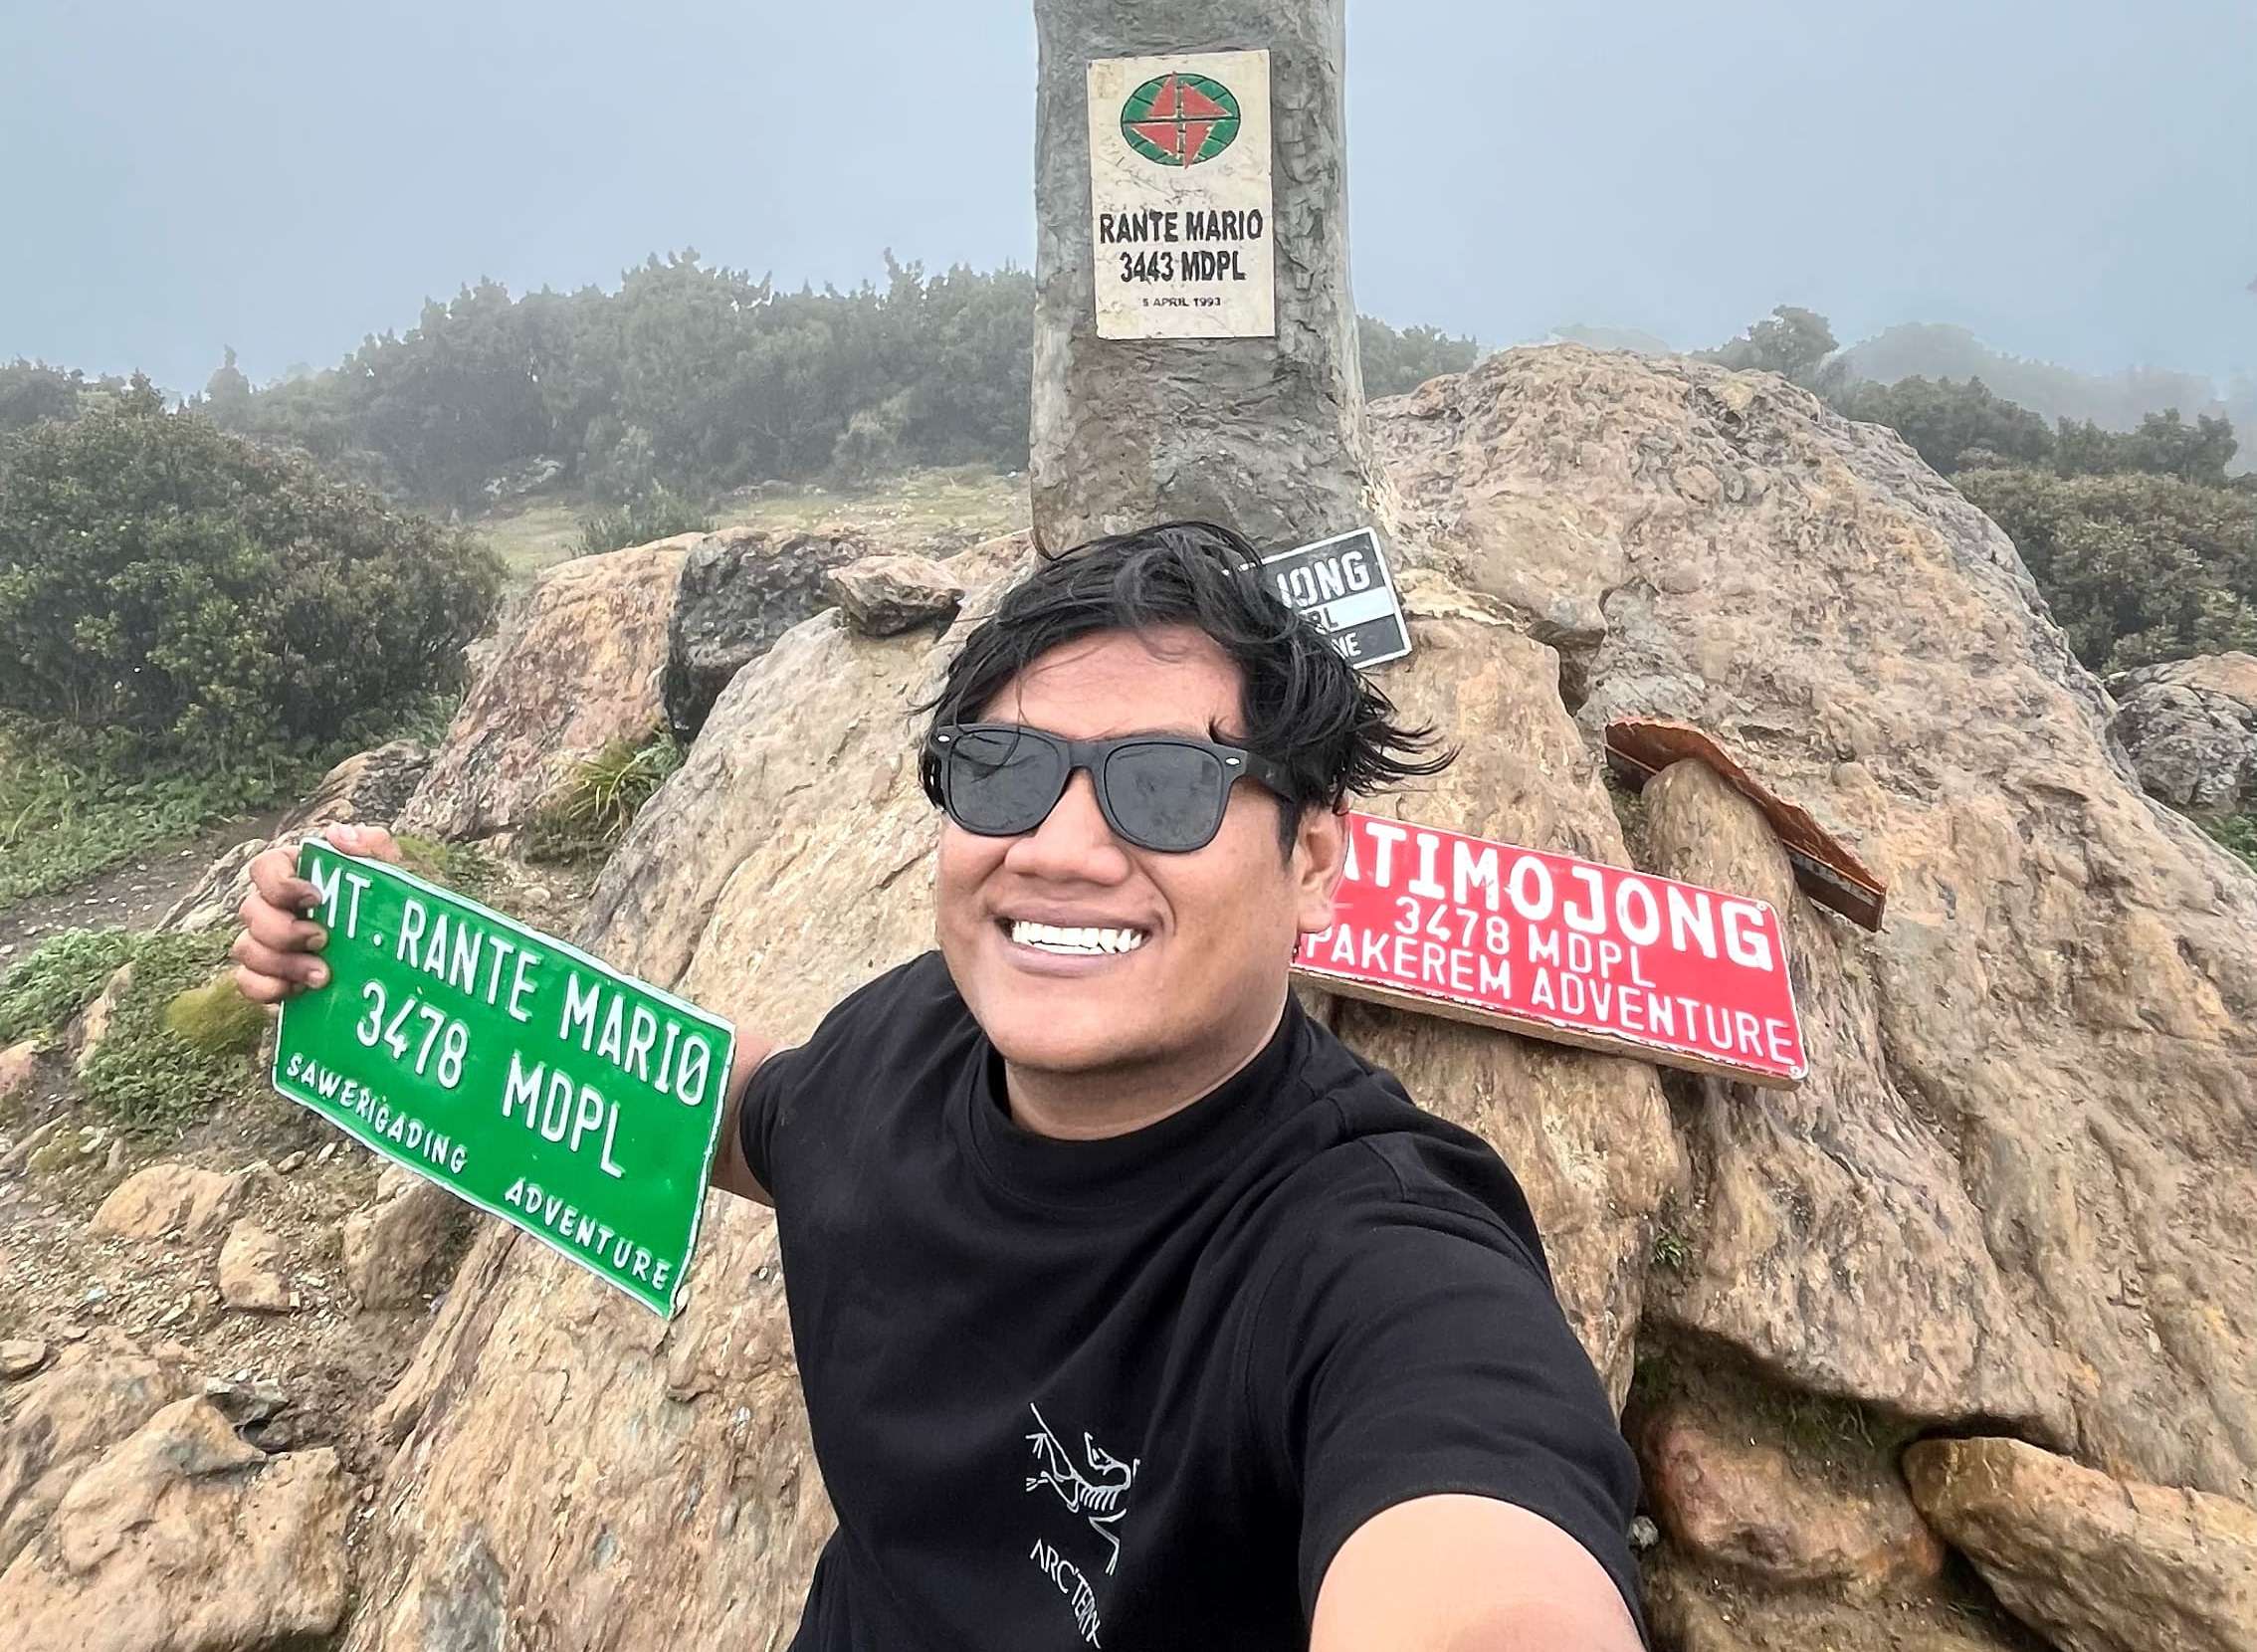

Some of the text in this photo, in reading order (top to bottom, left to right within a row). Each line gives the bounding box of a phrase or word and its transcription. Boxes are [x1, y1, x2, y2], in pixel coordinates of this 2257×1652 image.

[1100, 209, 1263, 244] RANTE MARIO
[1120, 250, 1246, 283] 3443 MDPL
[1153, 297, 1189, 308] APRIL
[1193, 297, 1221, 308] 1993
[310, 858, 383, 946] MT.
[397, 899, 541, 1023] RANTE
[1394, 896, 1656, 988] 3478 MDPL
[1531, 972, 1796, 1065] ADVENTURE
[356, 979, 624, 1178] 3478 MDPL
[286, 1053, 671, 1291] SAWERIGADING ADVENTURE
